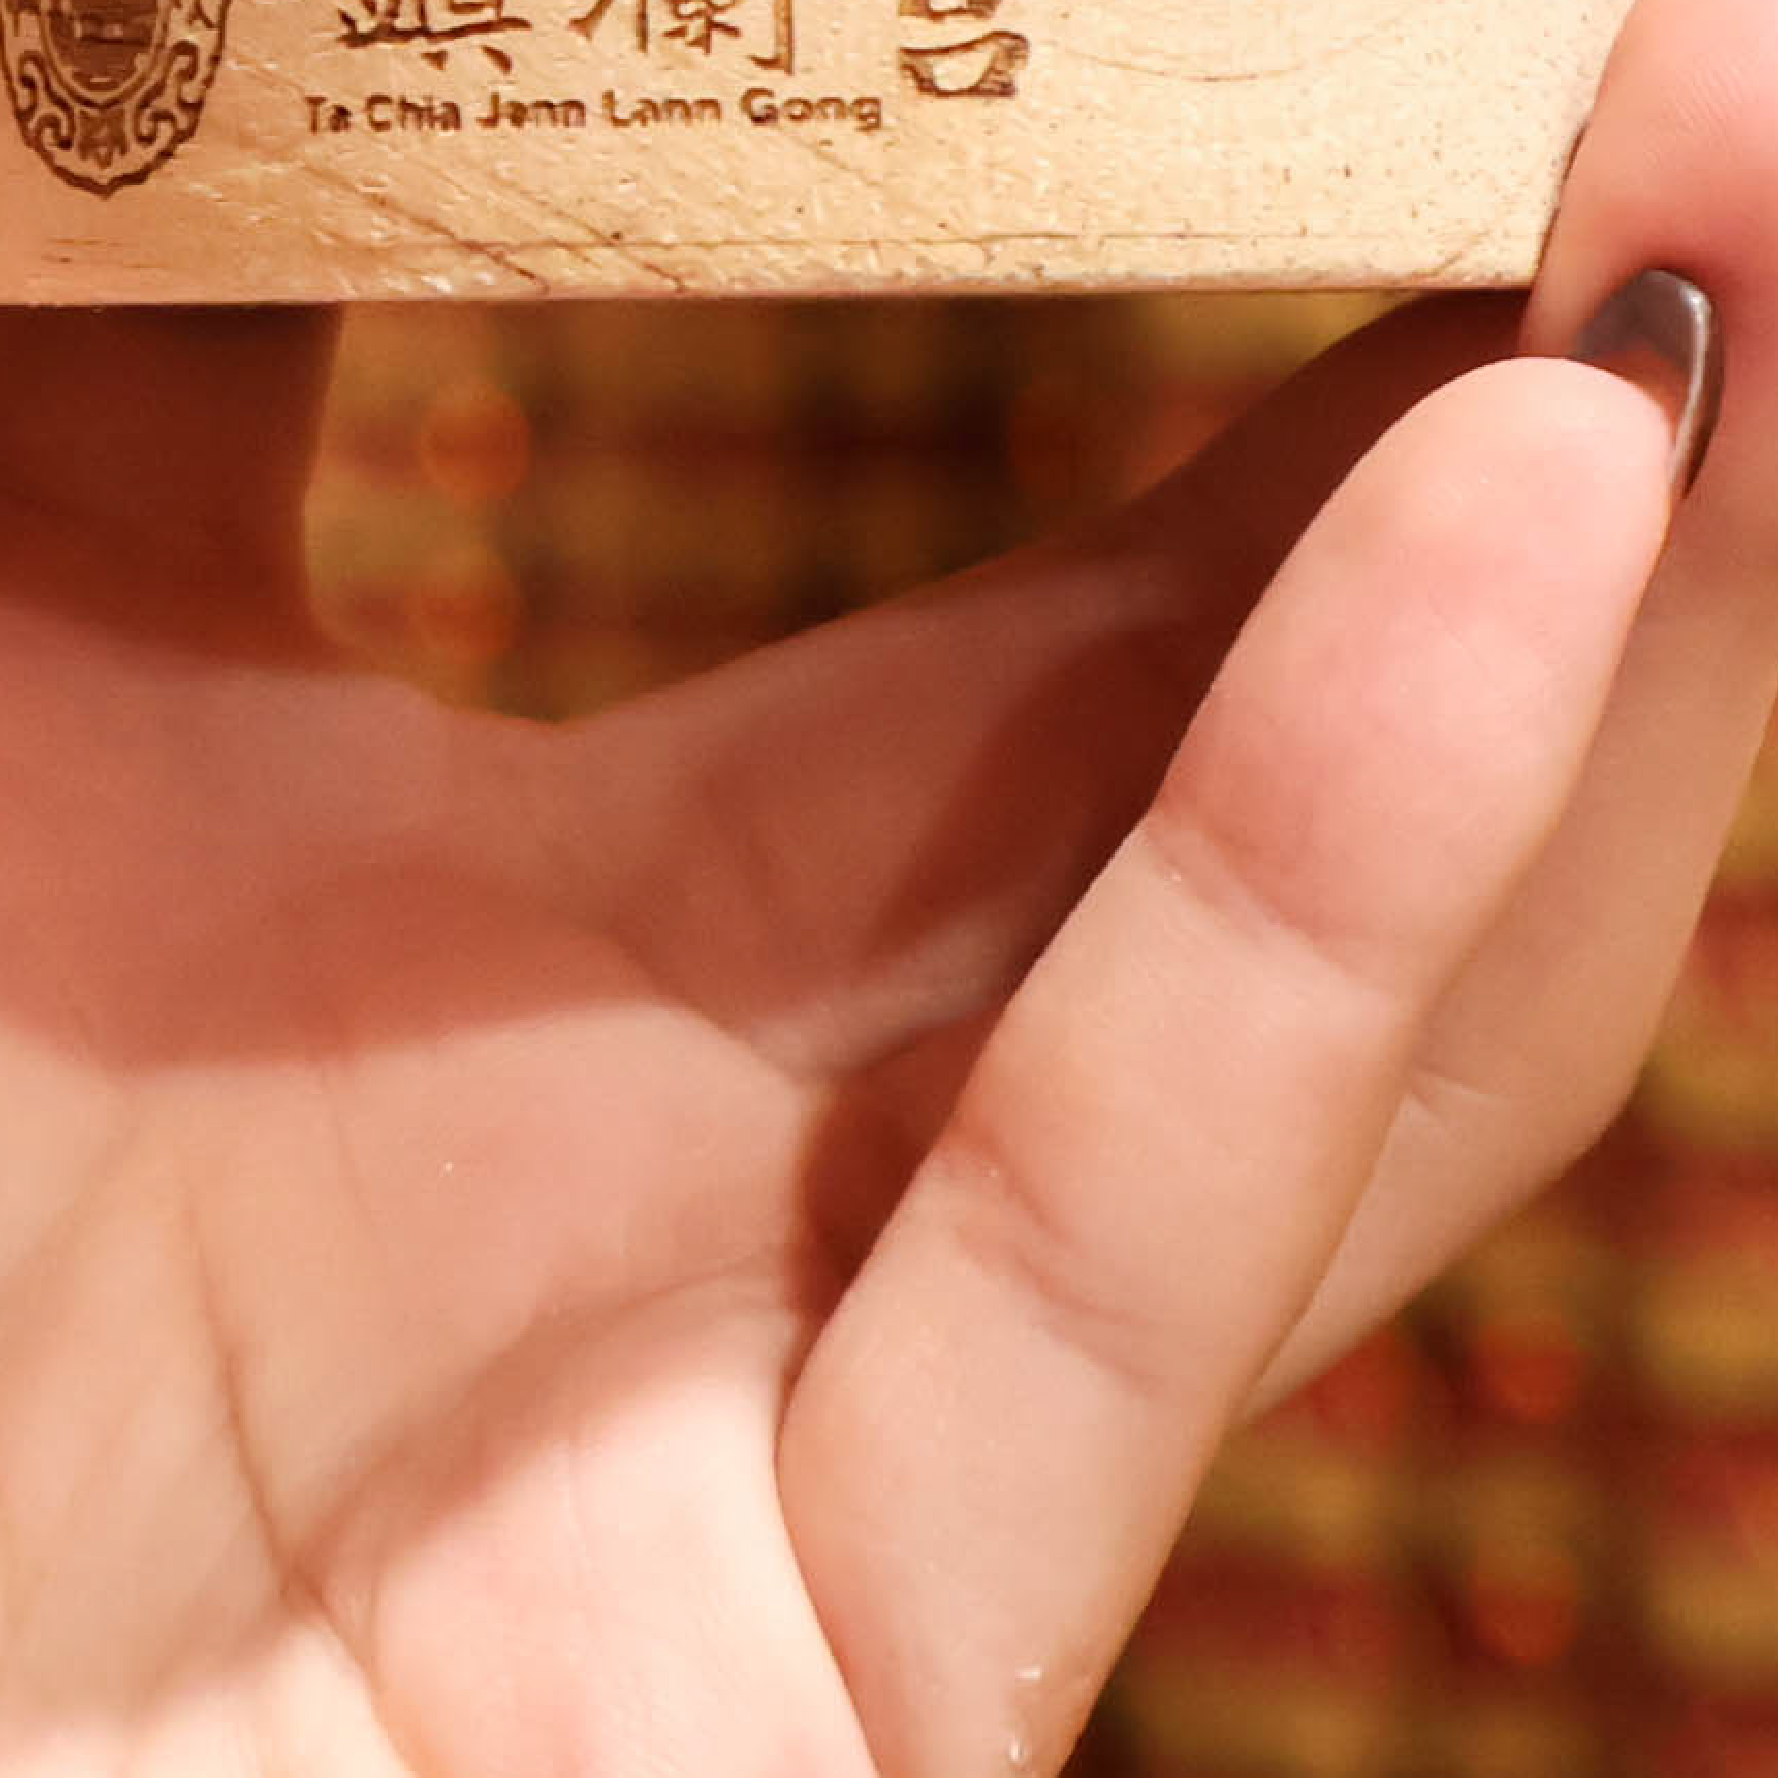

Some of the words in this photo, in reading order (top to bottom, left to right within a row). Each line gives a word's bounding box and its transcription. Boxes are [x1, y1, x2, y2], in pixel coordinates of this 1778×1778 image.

[305, 95, 352, 134] Ta
[365, 94, 461, 132] Chia
[600, 89, 722, 127] Lann
[739, 87, 882, 132] Gong
